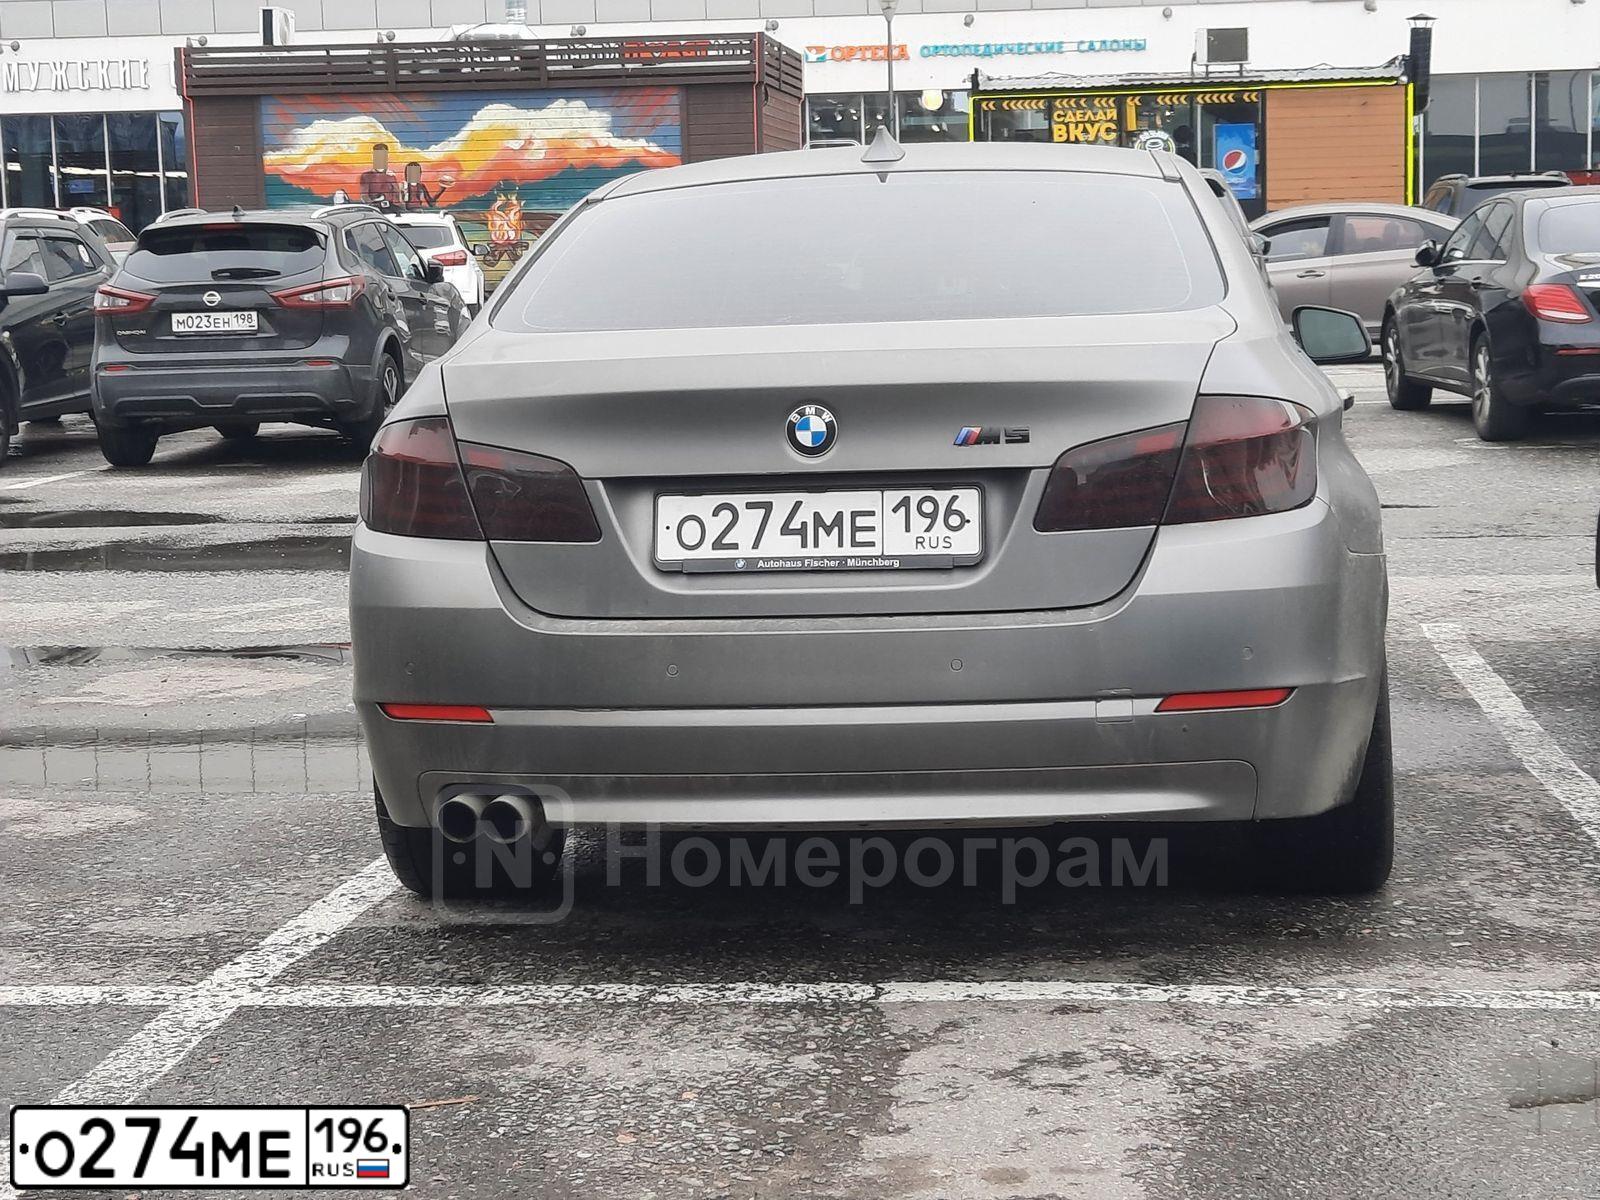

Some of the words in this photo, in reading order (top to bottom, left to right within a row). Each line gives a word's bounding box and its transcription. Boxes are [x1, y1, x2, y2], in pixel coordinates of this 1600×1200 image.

[831, 44, 910, 62] ОРТЕКА
[920, 42, 1065, 58] ОРТОПЕДИЧЕСКИЕ
[1077, 38, 1147, 53] САЛОНЫ
[3, 58, 150, 92] МУЖСКИЕ
[1053, 108, 1118, 122] СДЕЛАЙ
[1053, 122, 1118, 142] ВКУС
[176, 315, 231, 329] М023ЕН
[233, 313, 253, 324] 198
[790, 406, 833, 423] BMW
[676, 499, 877, 551] О274МЕ
[891, 494, 968, 533] 196
[914, 535, 952, 550] RUS
[757, 559, 803, 569] Autohaus
[804, 558, 840, 568] Fischer
[847, 557, 900, 569] Münchberg
